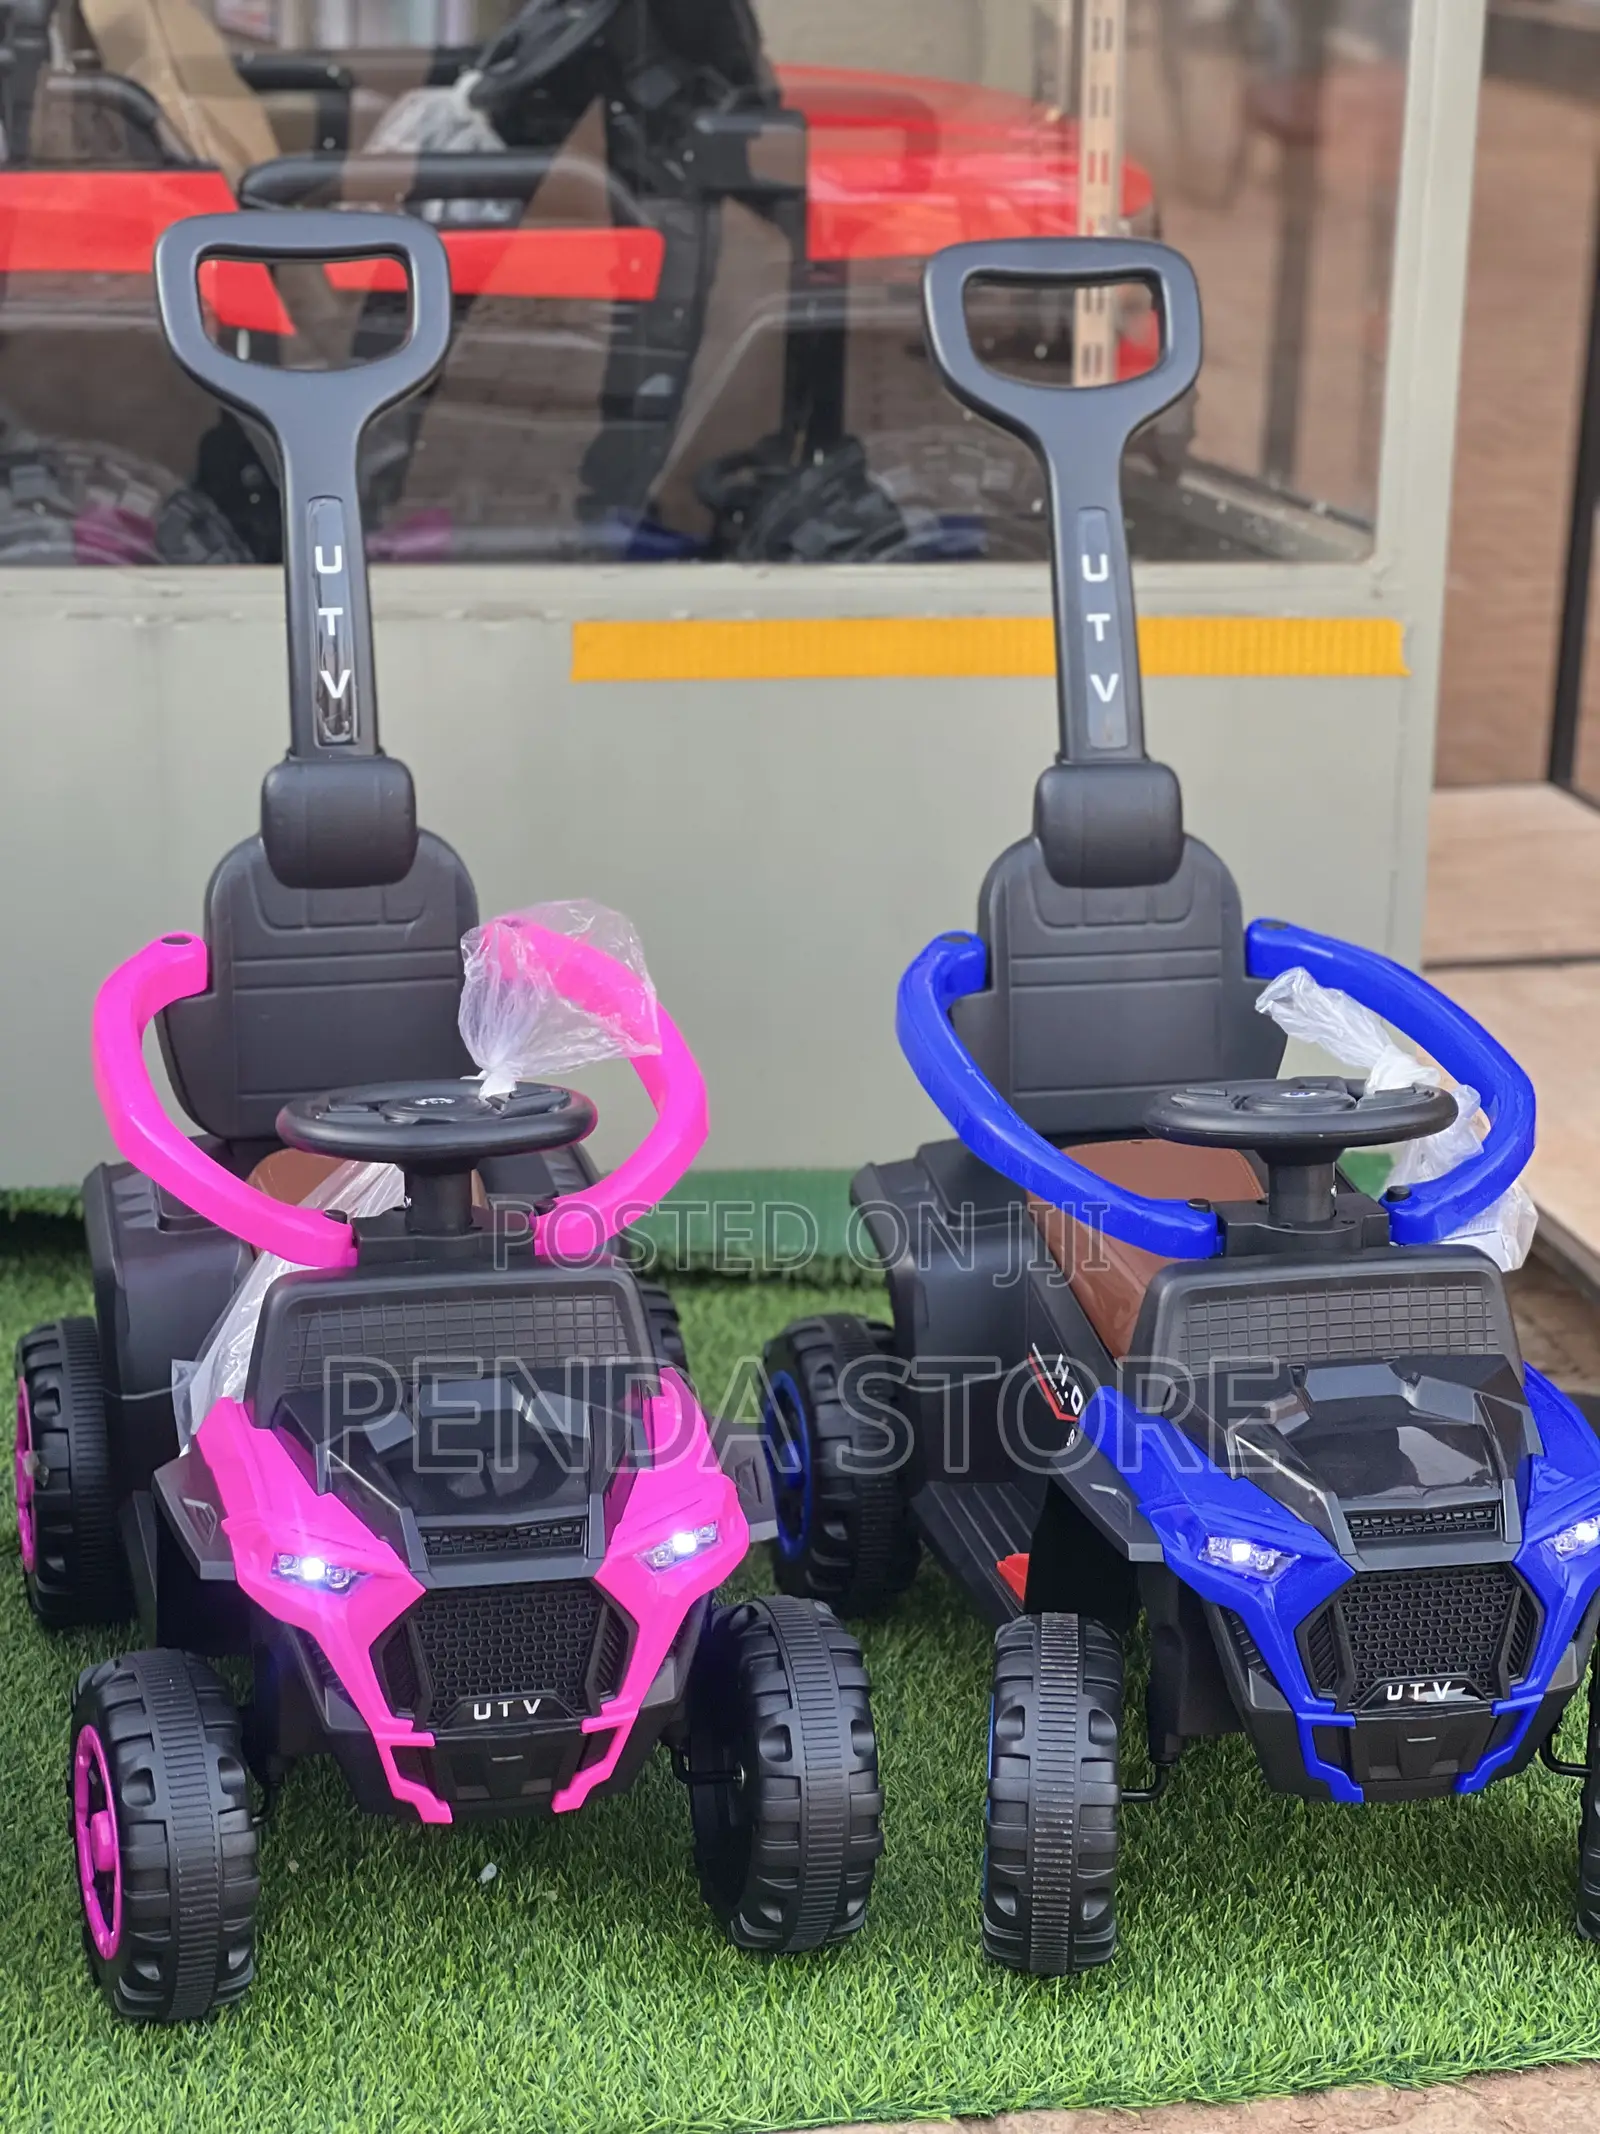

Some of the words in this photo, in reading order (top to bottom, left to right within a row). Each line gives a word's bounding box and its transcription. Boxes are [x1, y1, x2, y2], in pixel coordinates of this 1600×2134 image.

[315, 545, 351, 698] UTV
[1081, 553, 1119, 702] UTV
[473, 1698, 542, 1721] UTV
[1386, 1681, 1452, 1701] UTV
